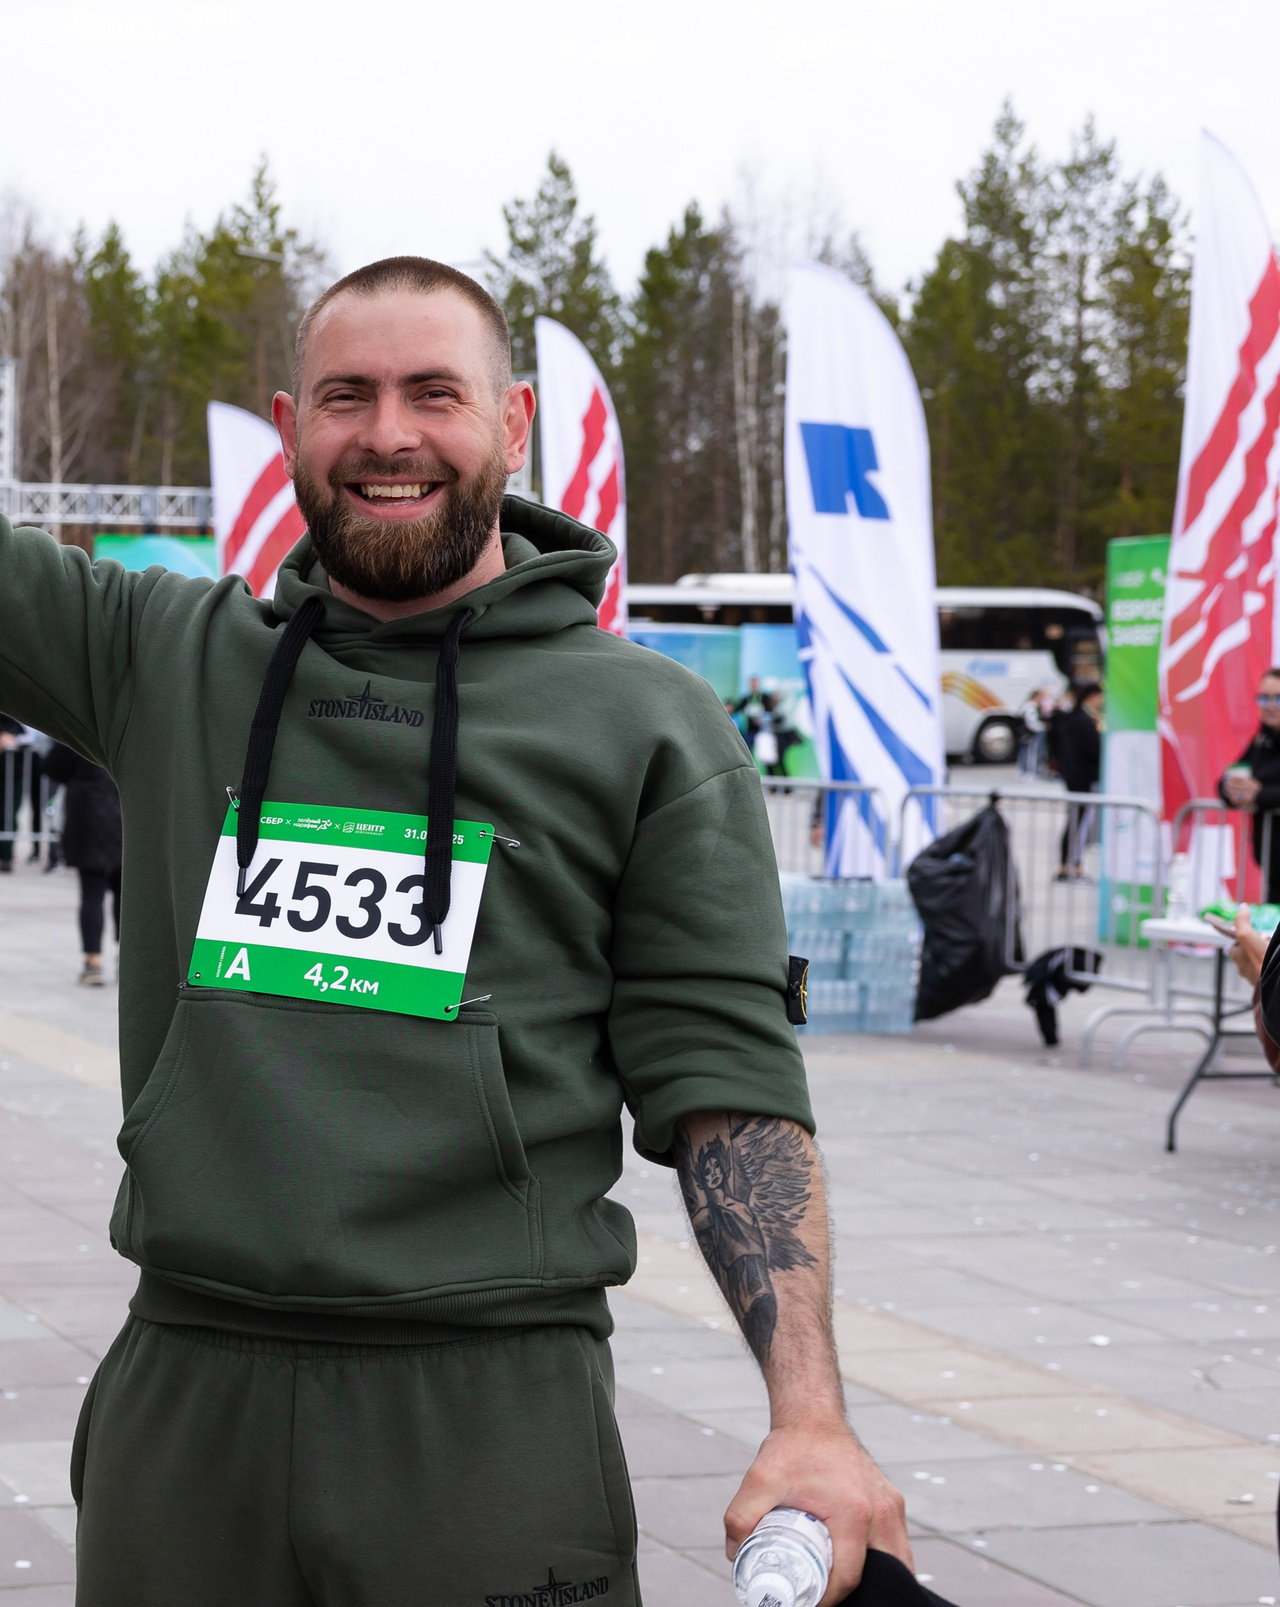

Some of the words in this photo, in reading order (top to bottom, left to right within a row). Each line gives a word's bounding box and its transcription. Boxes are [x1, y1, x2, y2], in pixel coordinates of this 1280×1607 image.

[308, 700, 359, 718] STONE
[364, 703, 424, 727] ISLAND
[260, 816, 283, 825] СБЕР
[356, 823, 385, 832] ЦЕНТР
[404, 828, 464, 845] 31.025
[235, 858, 433, 947] 4533
[304, 963, 349, 992] 4,2
[554, 1576, 609, 1607] ISLAND
